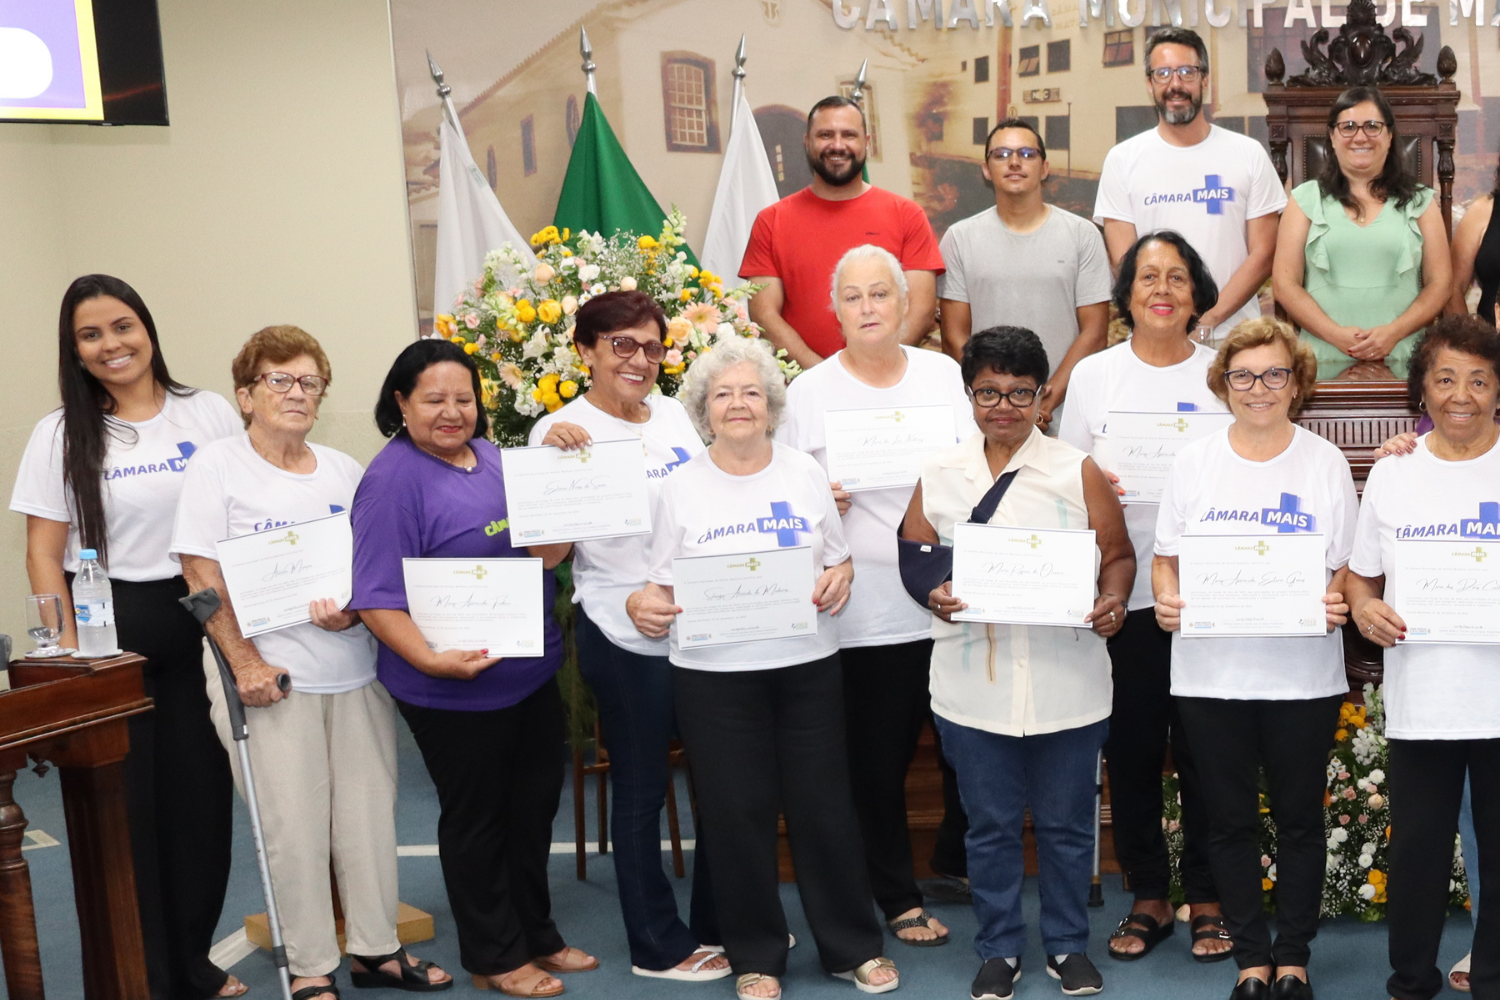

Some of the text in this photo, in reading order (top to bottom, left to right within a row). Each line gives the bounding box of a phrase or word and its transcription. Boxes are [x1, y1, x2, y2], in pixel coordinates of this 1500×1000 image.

[1144, 188, 1229, 206] CÂMARA MAIS
[1200, 507, 1308, 527] CÂMARA MAIS
[697, 517, 803, 544] CÂMARA MAIS
[1396, 524, 1458, 538] CÂMARA
